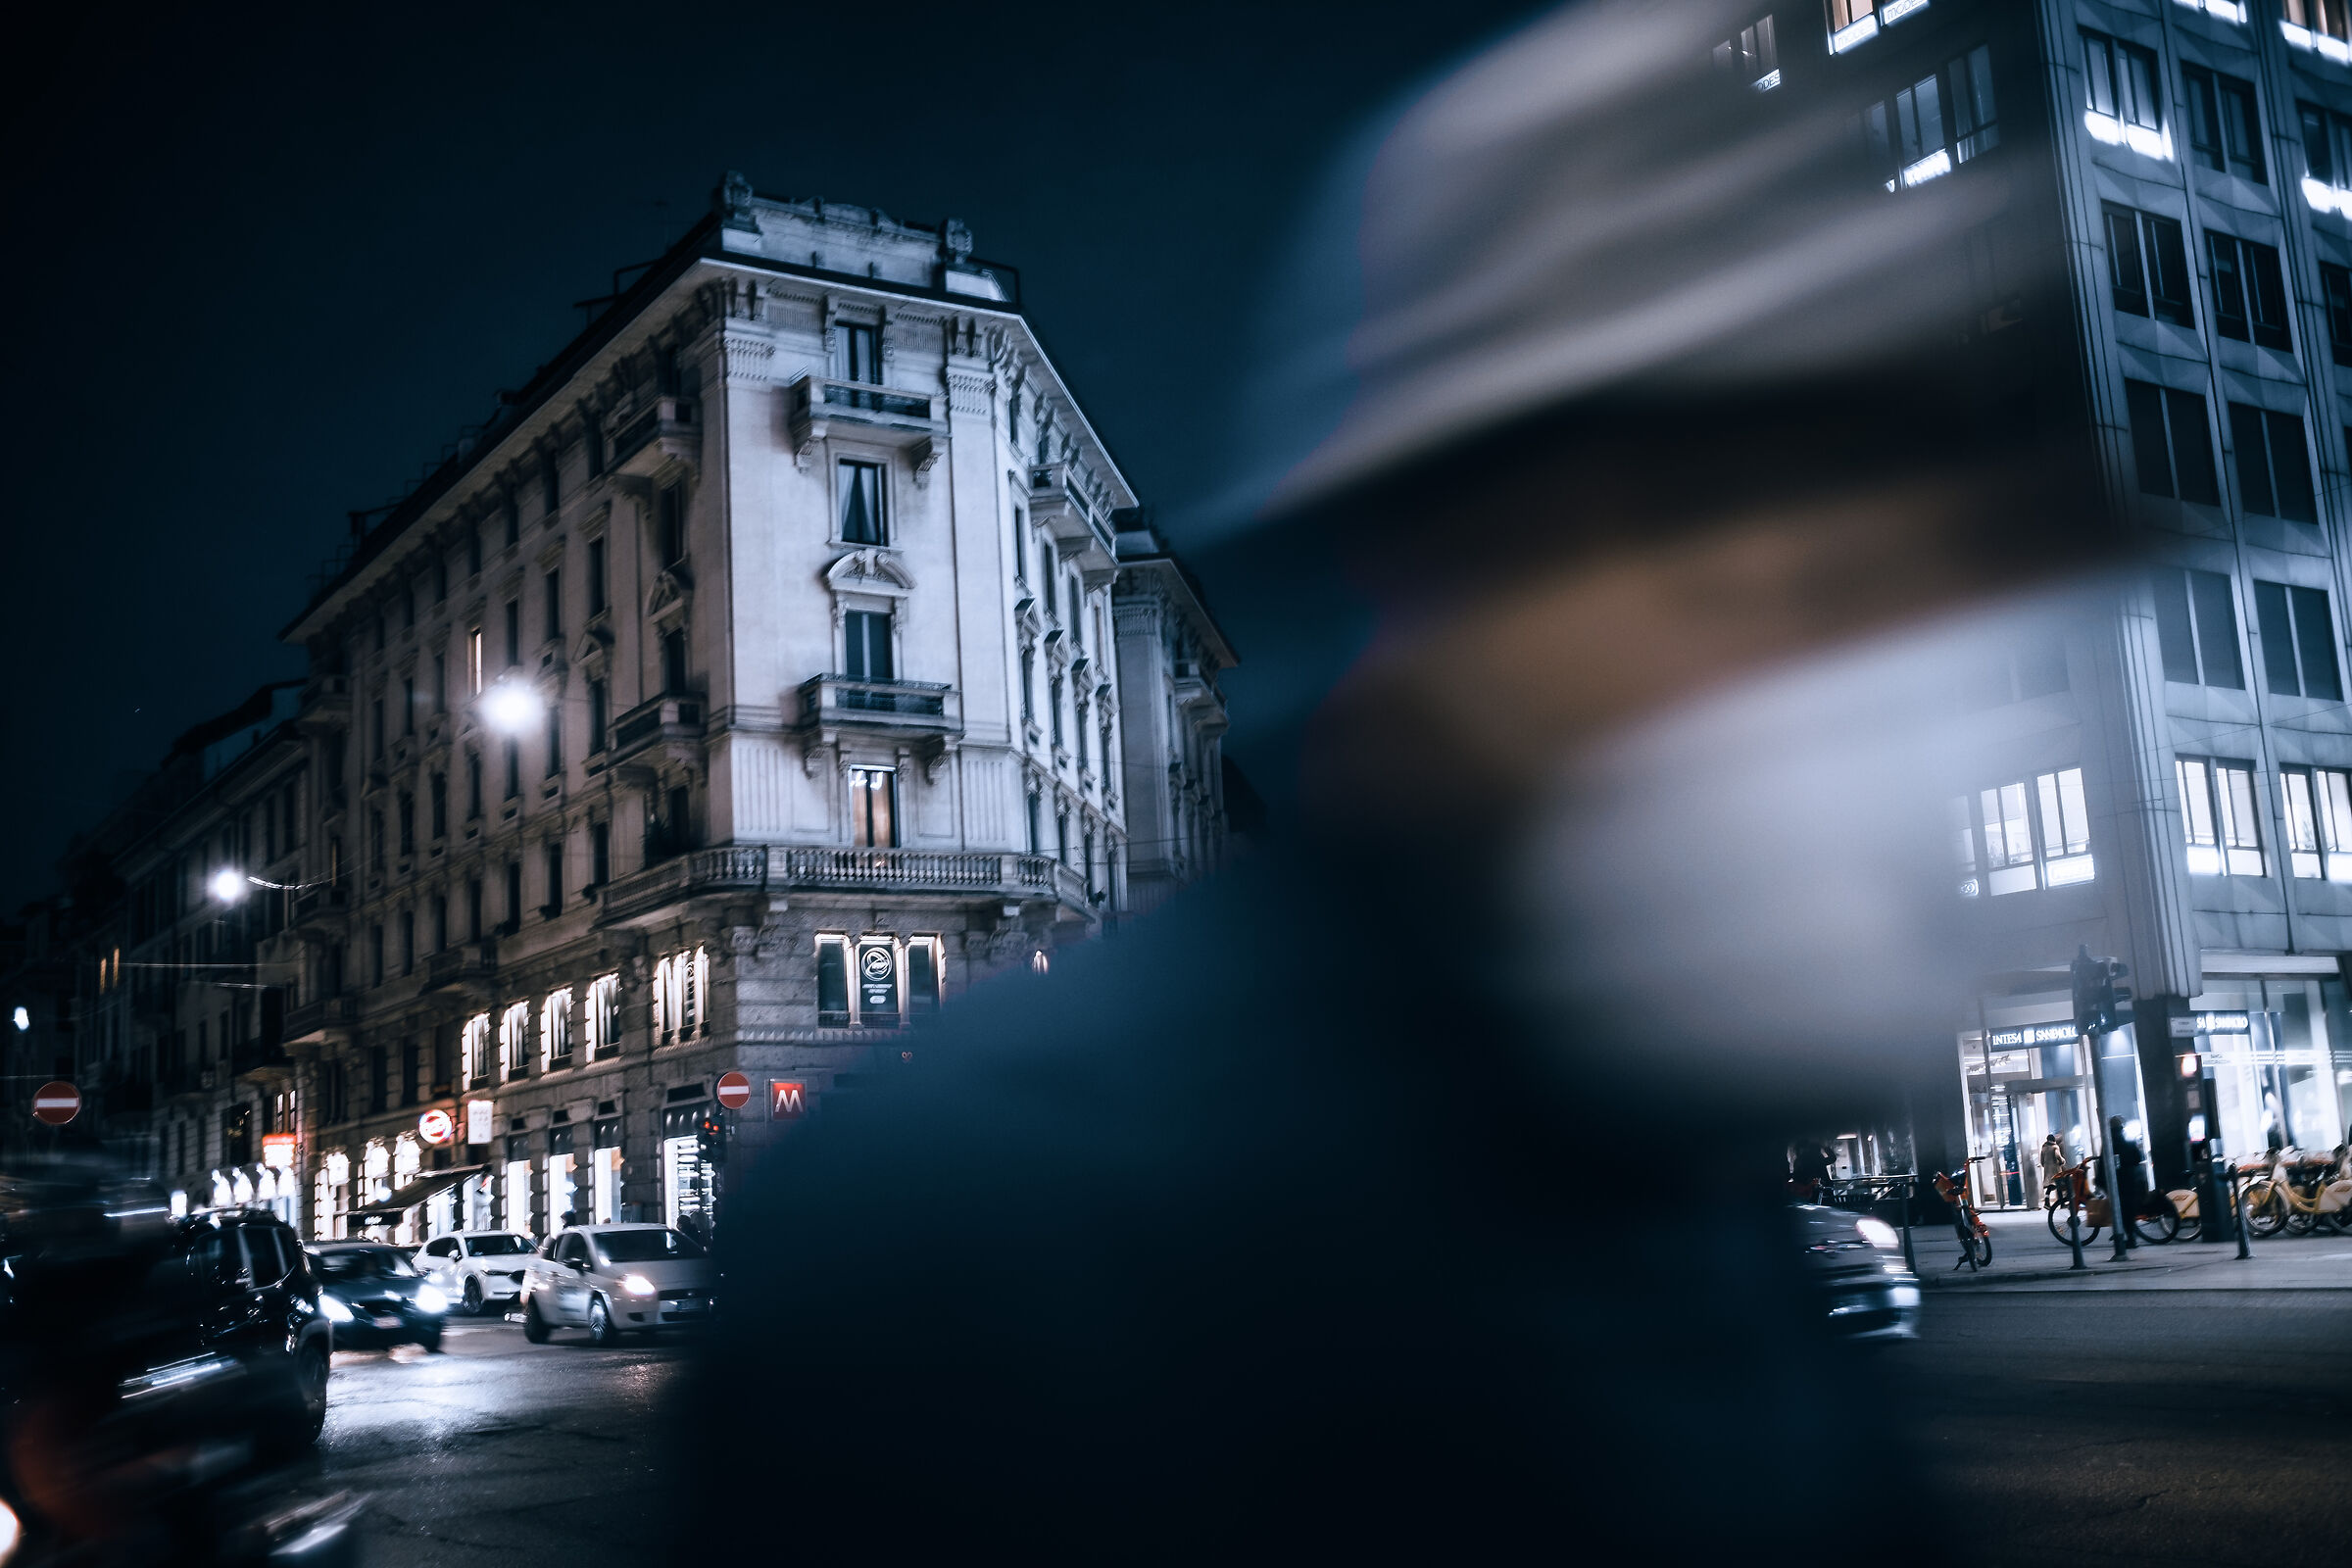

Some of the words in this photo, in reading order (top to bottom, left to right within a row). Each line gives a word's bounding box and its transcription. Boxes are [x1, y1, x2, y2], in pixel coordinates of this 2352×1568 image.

[1756, 72, 1781, 91] ODES
[1992, 1032, 2023, 1046] INTESA
[775, 1089, 804, 1112] M
